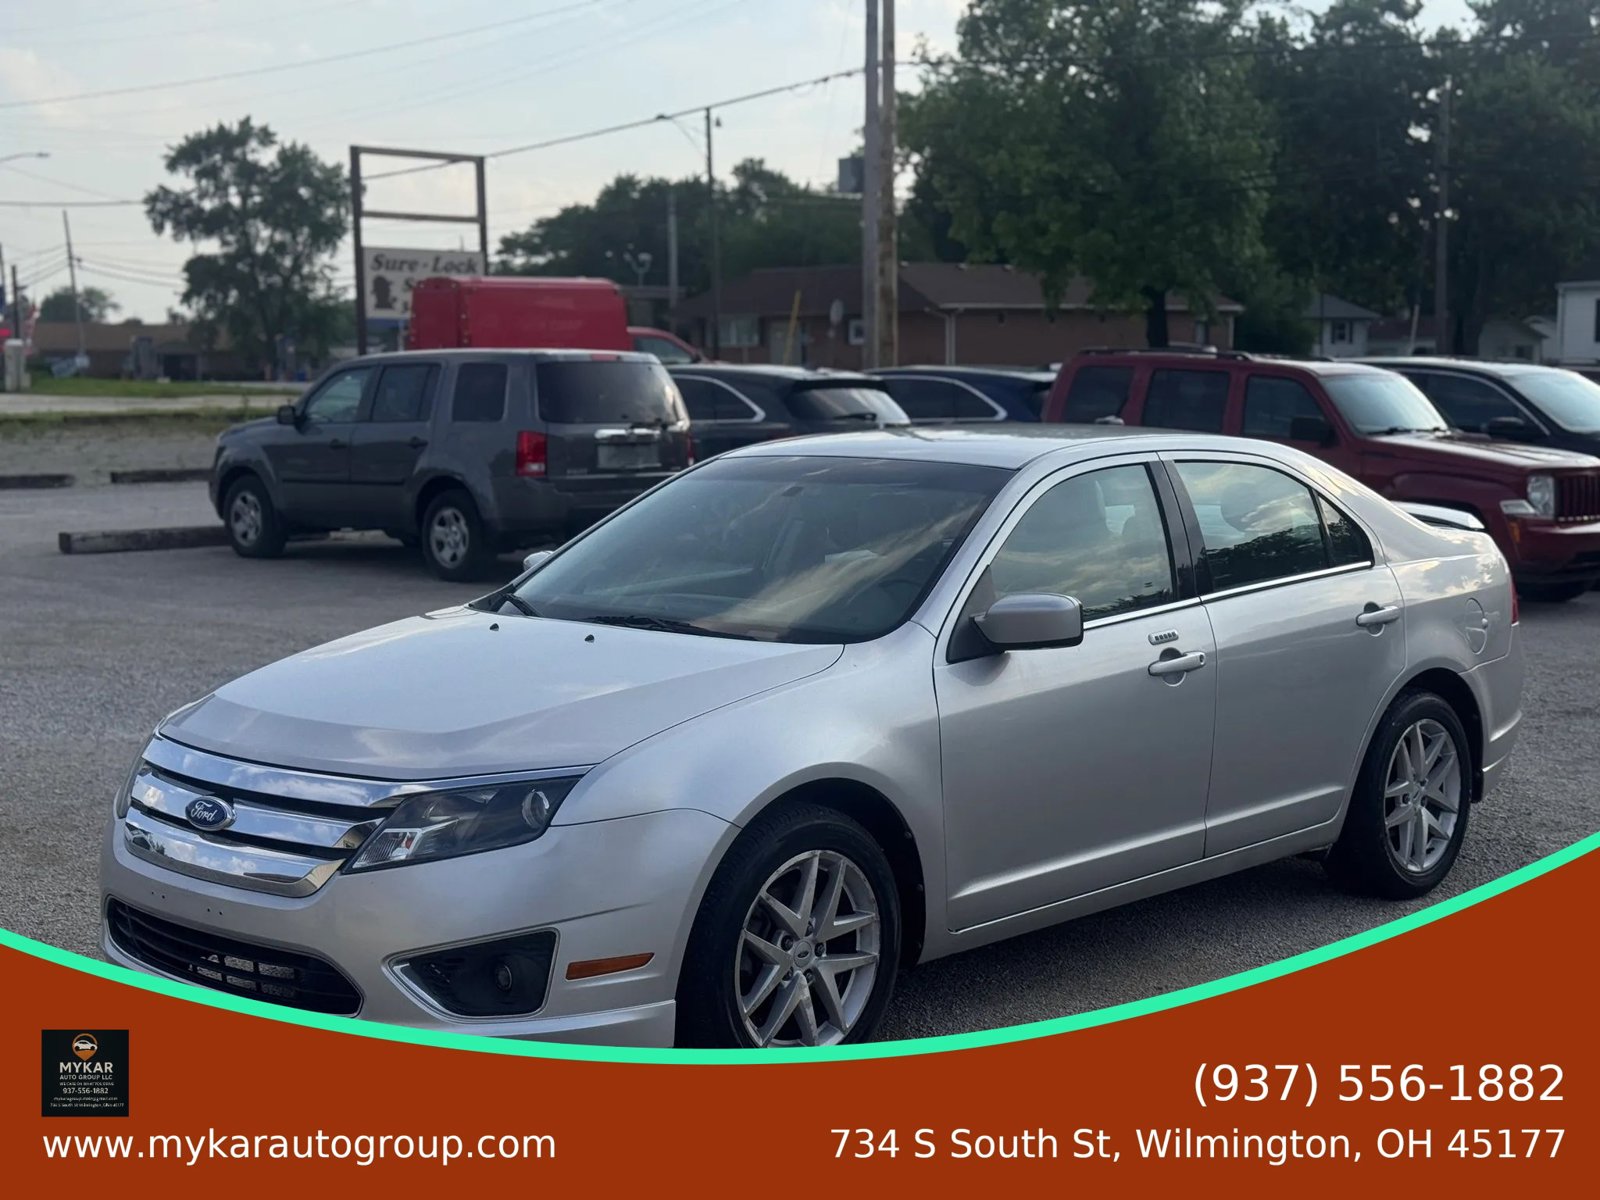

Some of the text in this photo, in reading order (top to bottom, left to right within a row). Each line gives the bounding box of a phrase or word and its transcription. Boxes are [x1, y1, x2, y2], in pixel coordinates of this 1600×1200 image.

[371, 254, 418, 272] Sure
[432, 256, 477, 273] Lock
[191, 801, 217, 821] Ford
